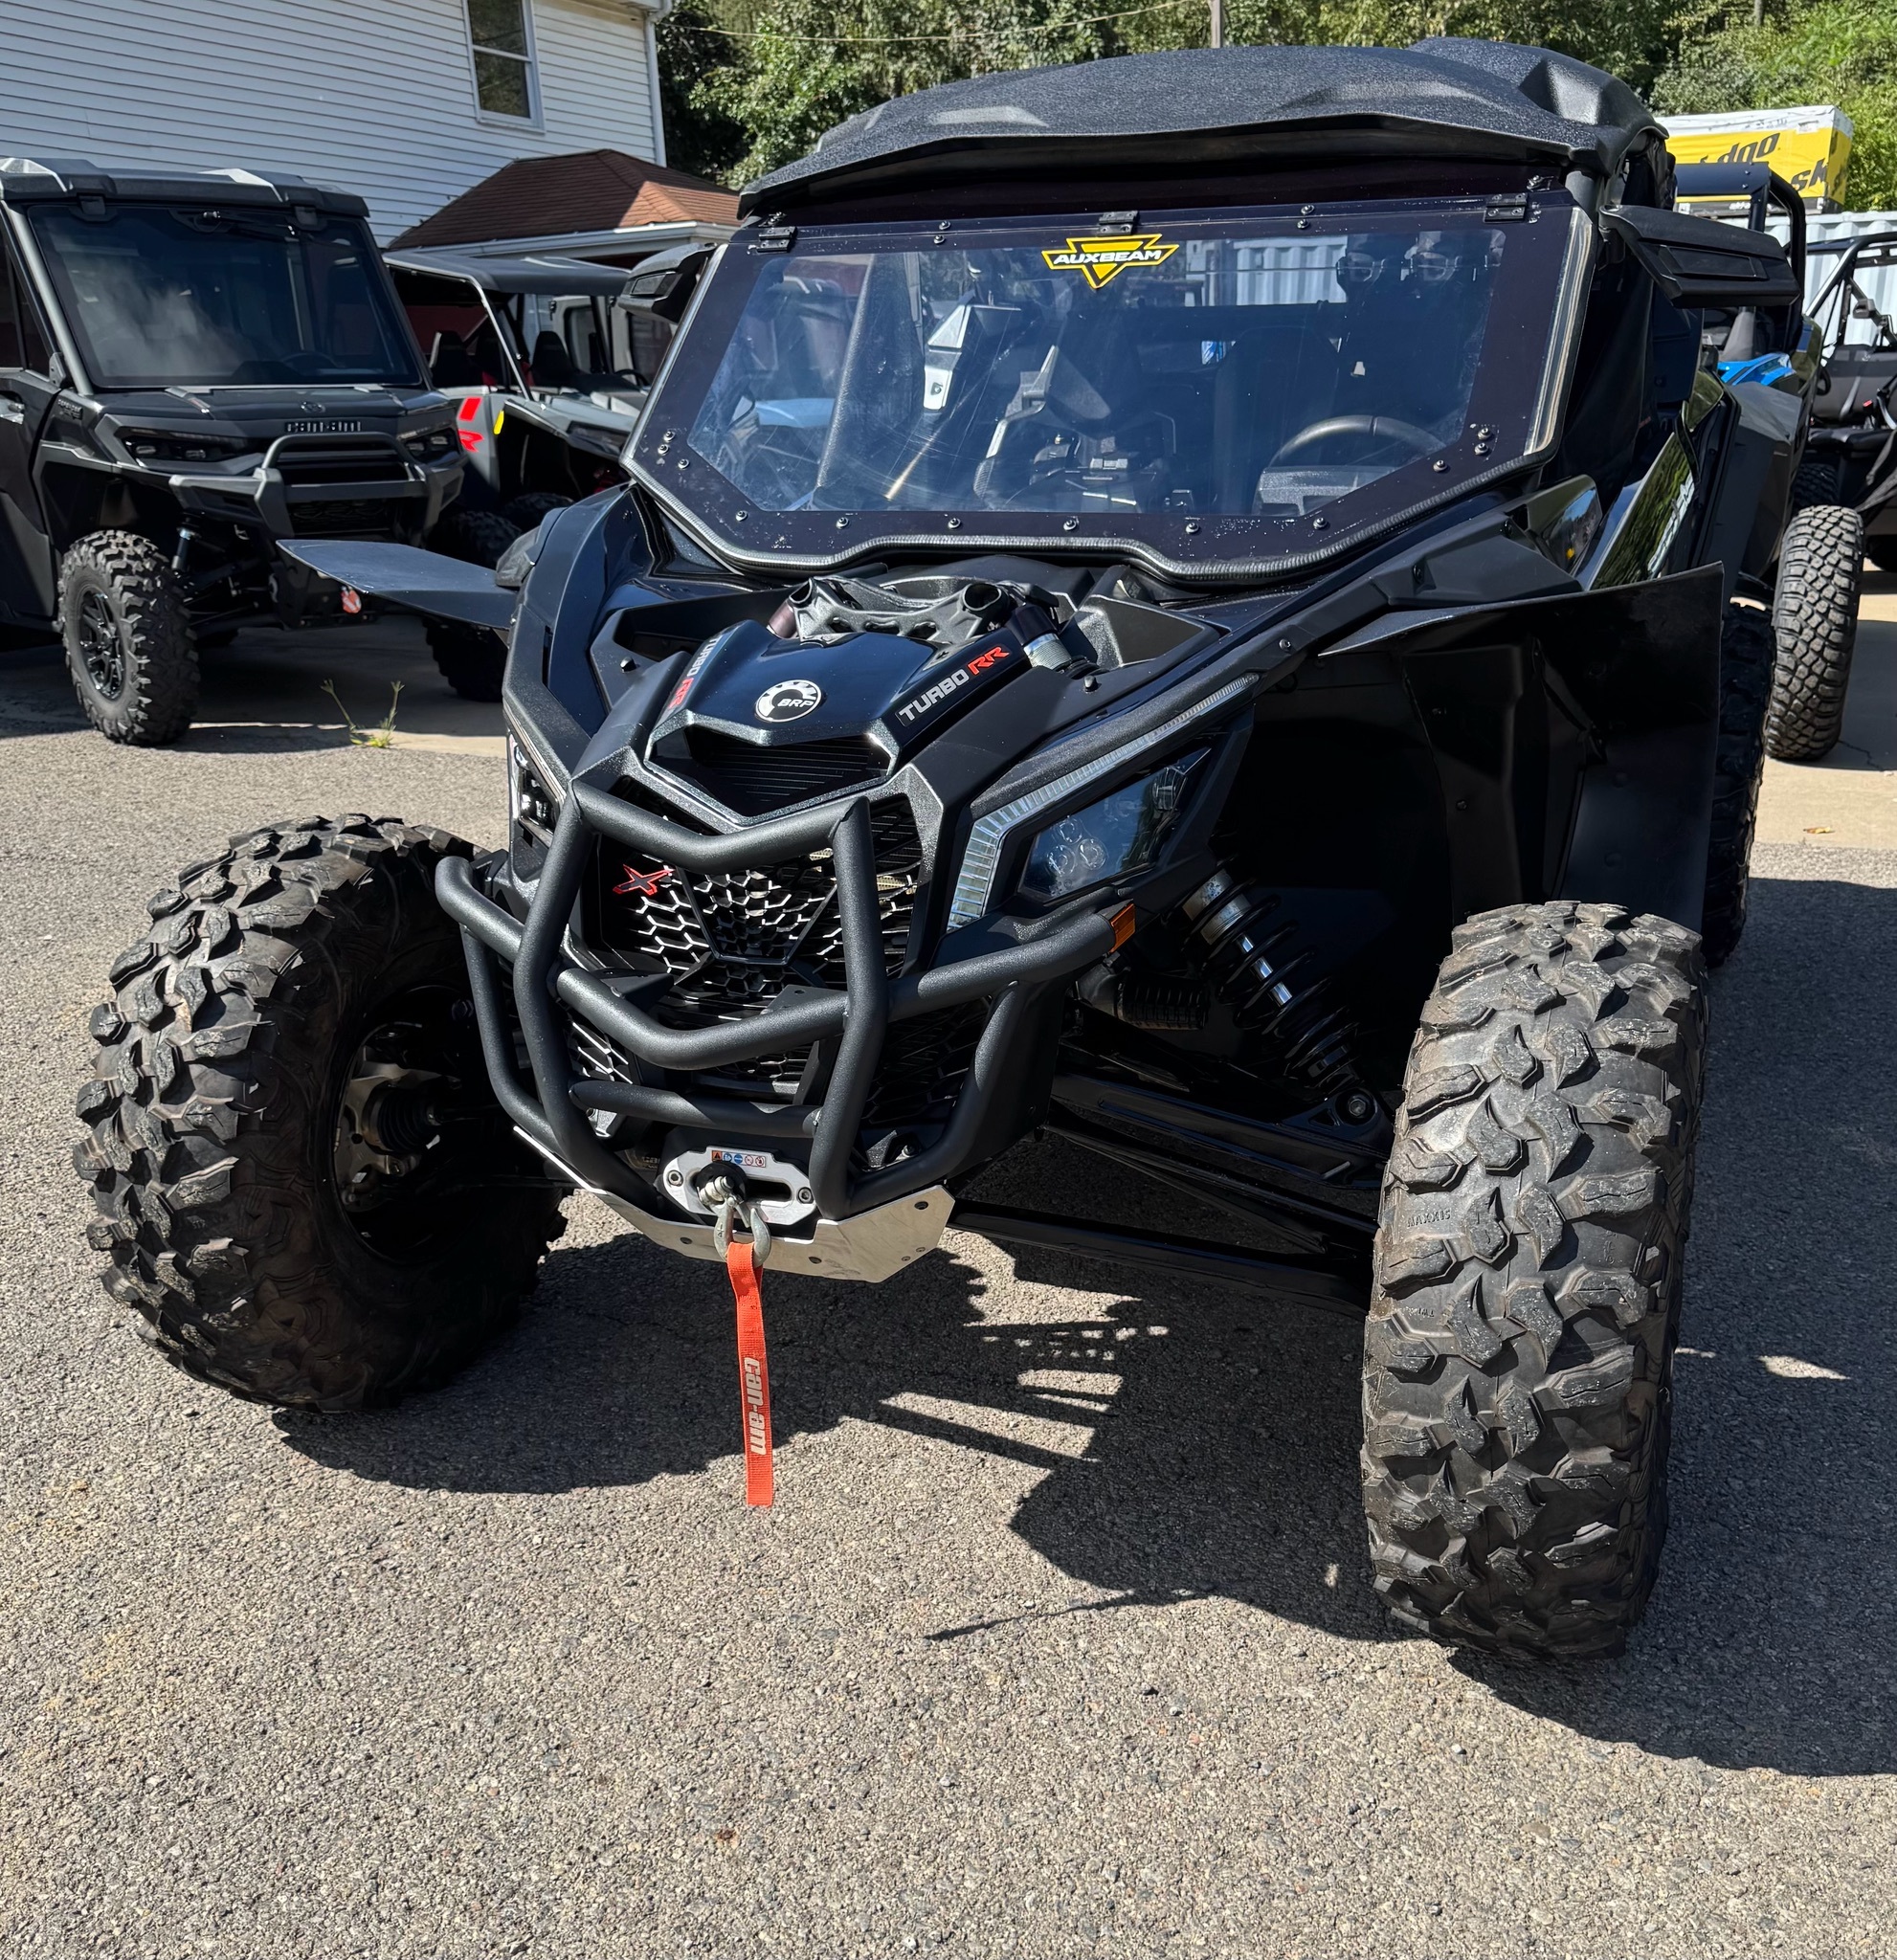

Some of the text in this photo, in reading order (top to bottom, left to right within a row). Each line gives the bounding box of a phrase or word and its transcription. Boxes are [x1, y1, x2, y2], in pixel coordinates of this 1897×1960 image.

[1054, 250, 1162, 264] AUXBEAM
[668, 635, 724, 709] TURBO RR
[899, 646, 1010, 722] TURBO RR
[777, 698, 815, 707] BRP
[1407, 1207, 1452, 1228] MAXXIS
[744, 1356, 767, 1456] can-am
